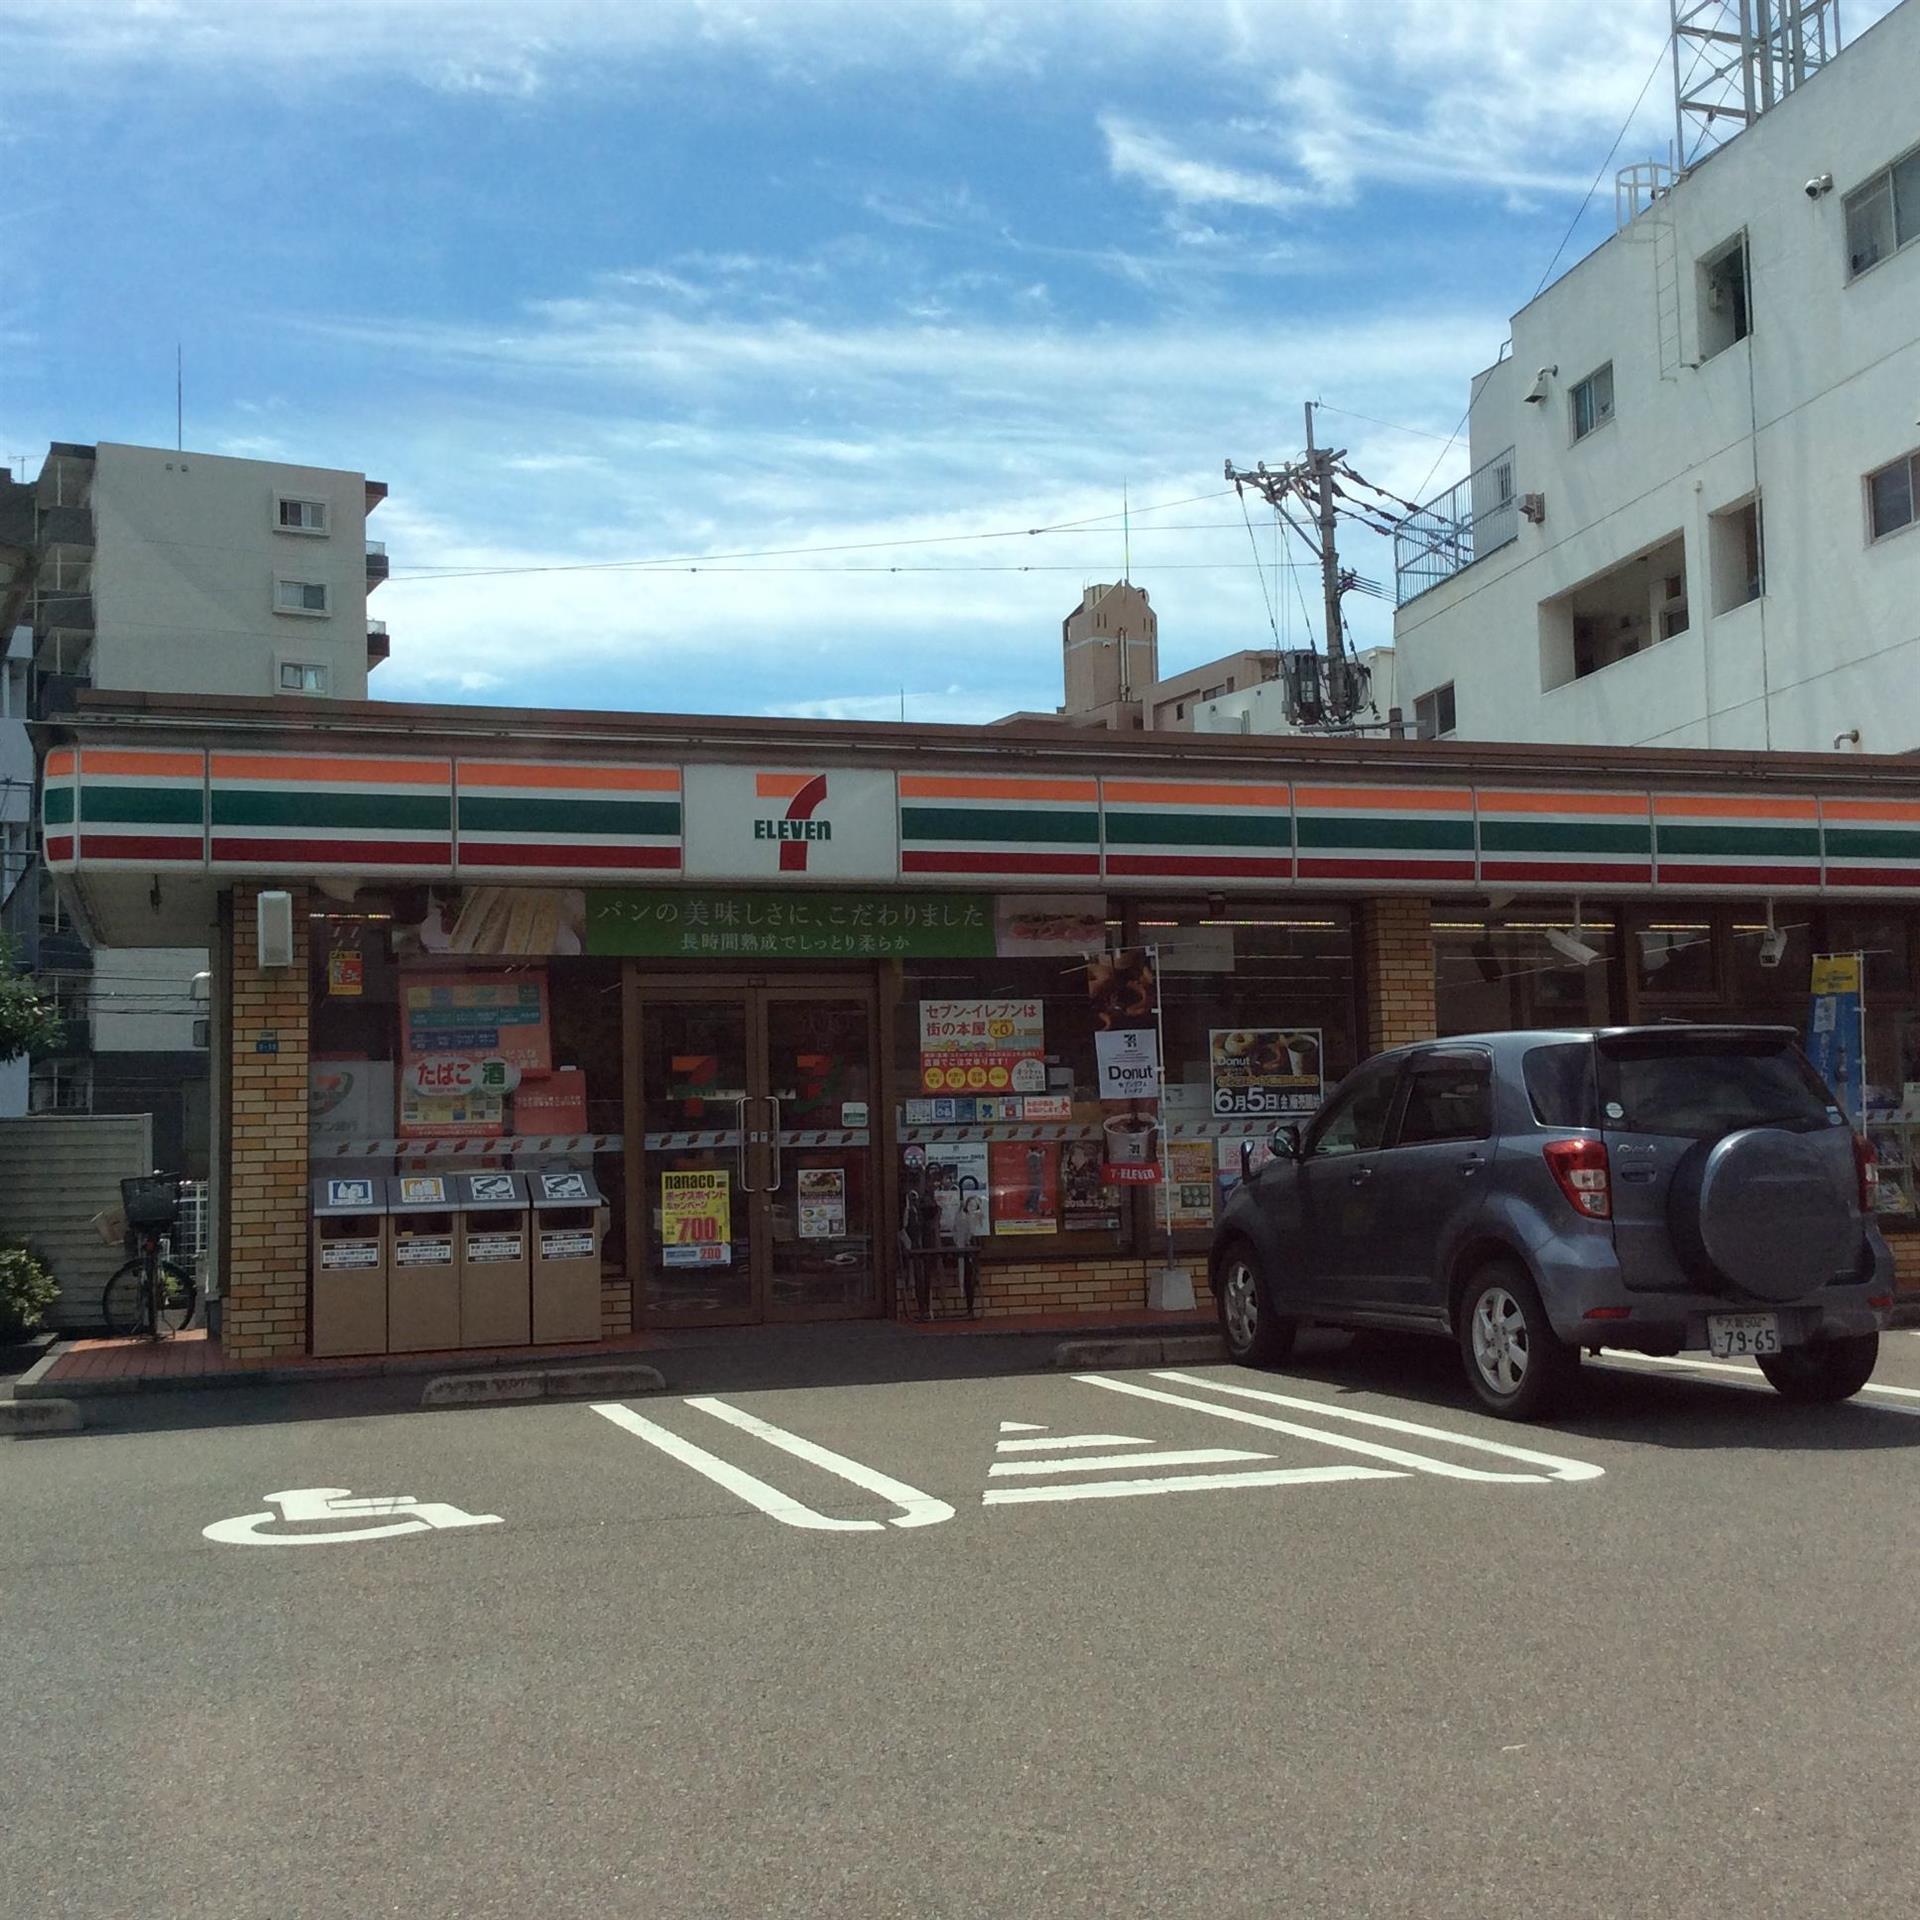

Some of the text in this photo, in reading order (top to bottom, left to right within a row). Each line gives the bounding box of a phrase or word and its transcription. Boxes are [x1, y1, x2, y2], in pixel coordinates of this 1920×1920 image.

[757, 773, 827, 871] 7
[598, 900, 985, 928] パンの美味しさに、こだわりました
[681, 933, 910, 951] 長時間熟成でしっとり柔らか
[927, 1021, 986, 1037] 街の本屋
[1219, 1056, 1250, 1066] Donut
[417, 1061, 506, 1086] たばこ 酒
[1108, 1064, 1153, 1080] Donut
[665, 1174, 715, 1190] nanaco
[676, 1217, 718, 1241] 700
[1725, 1329, 1775, 1352] 79-65
